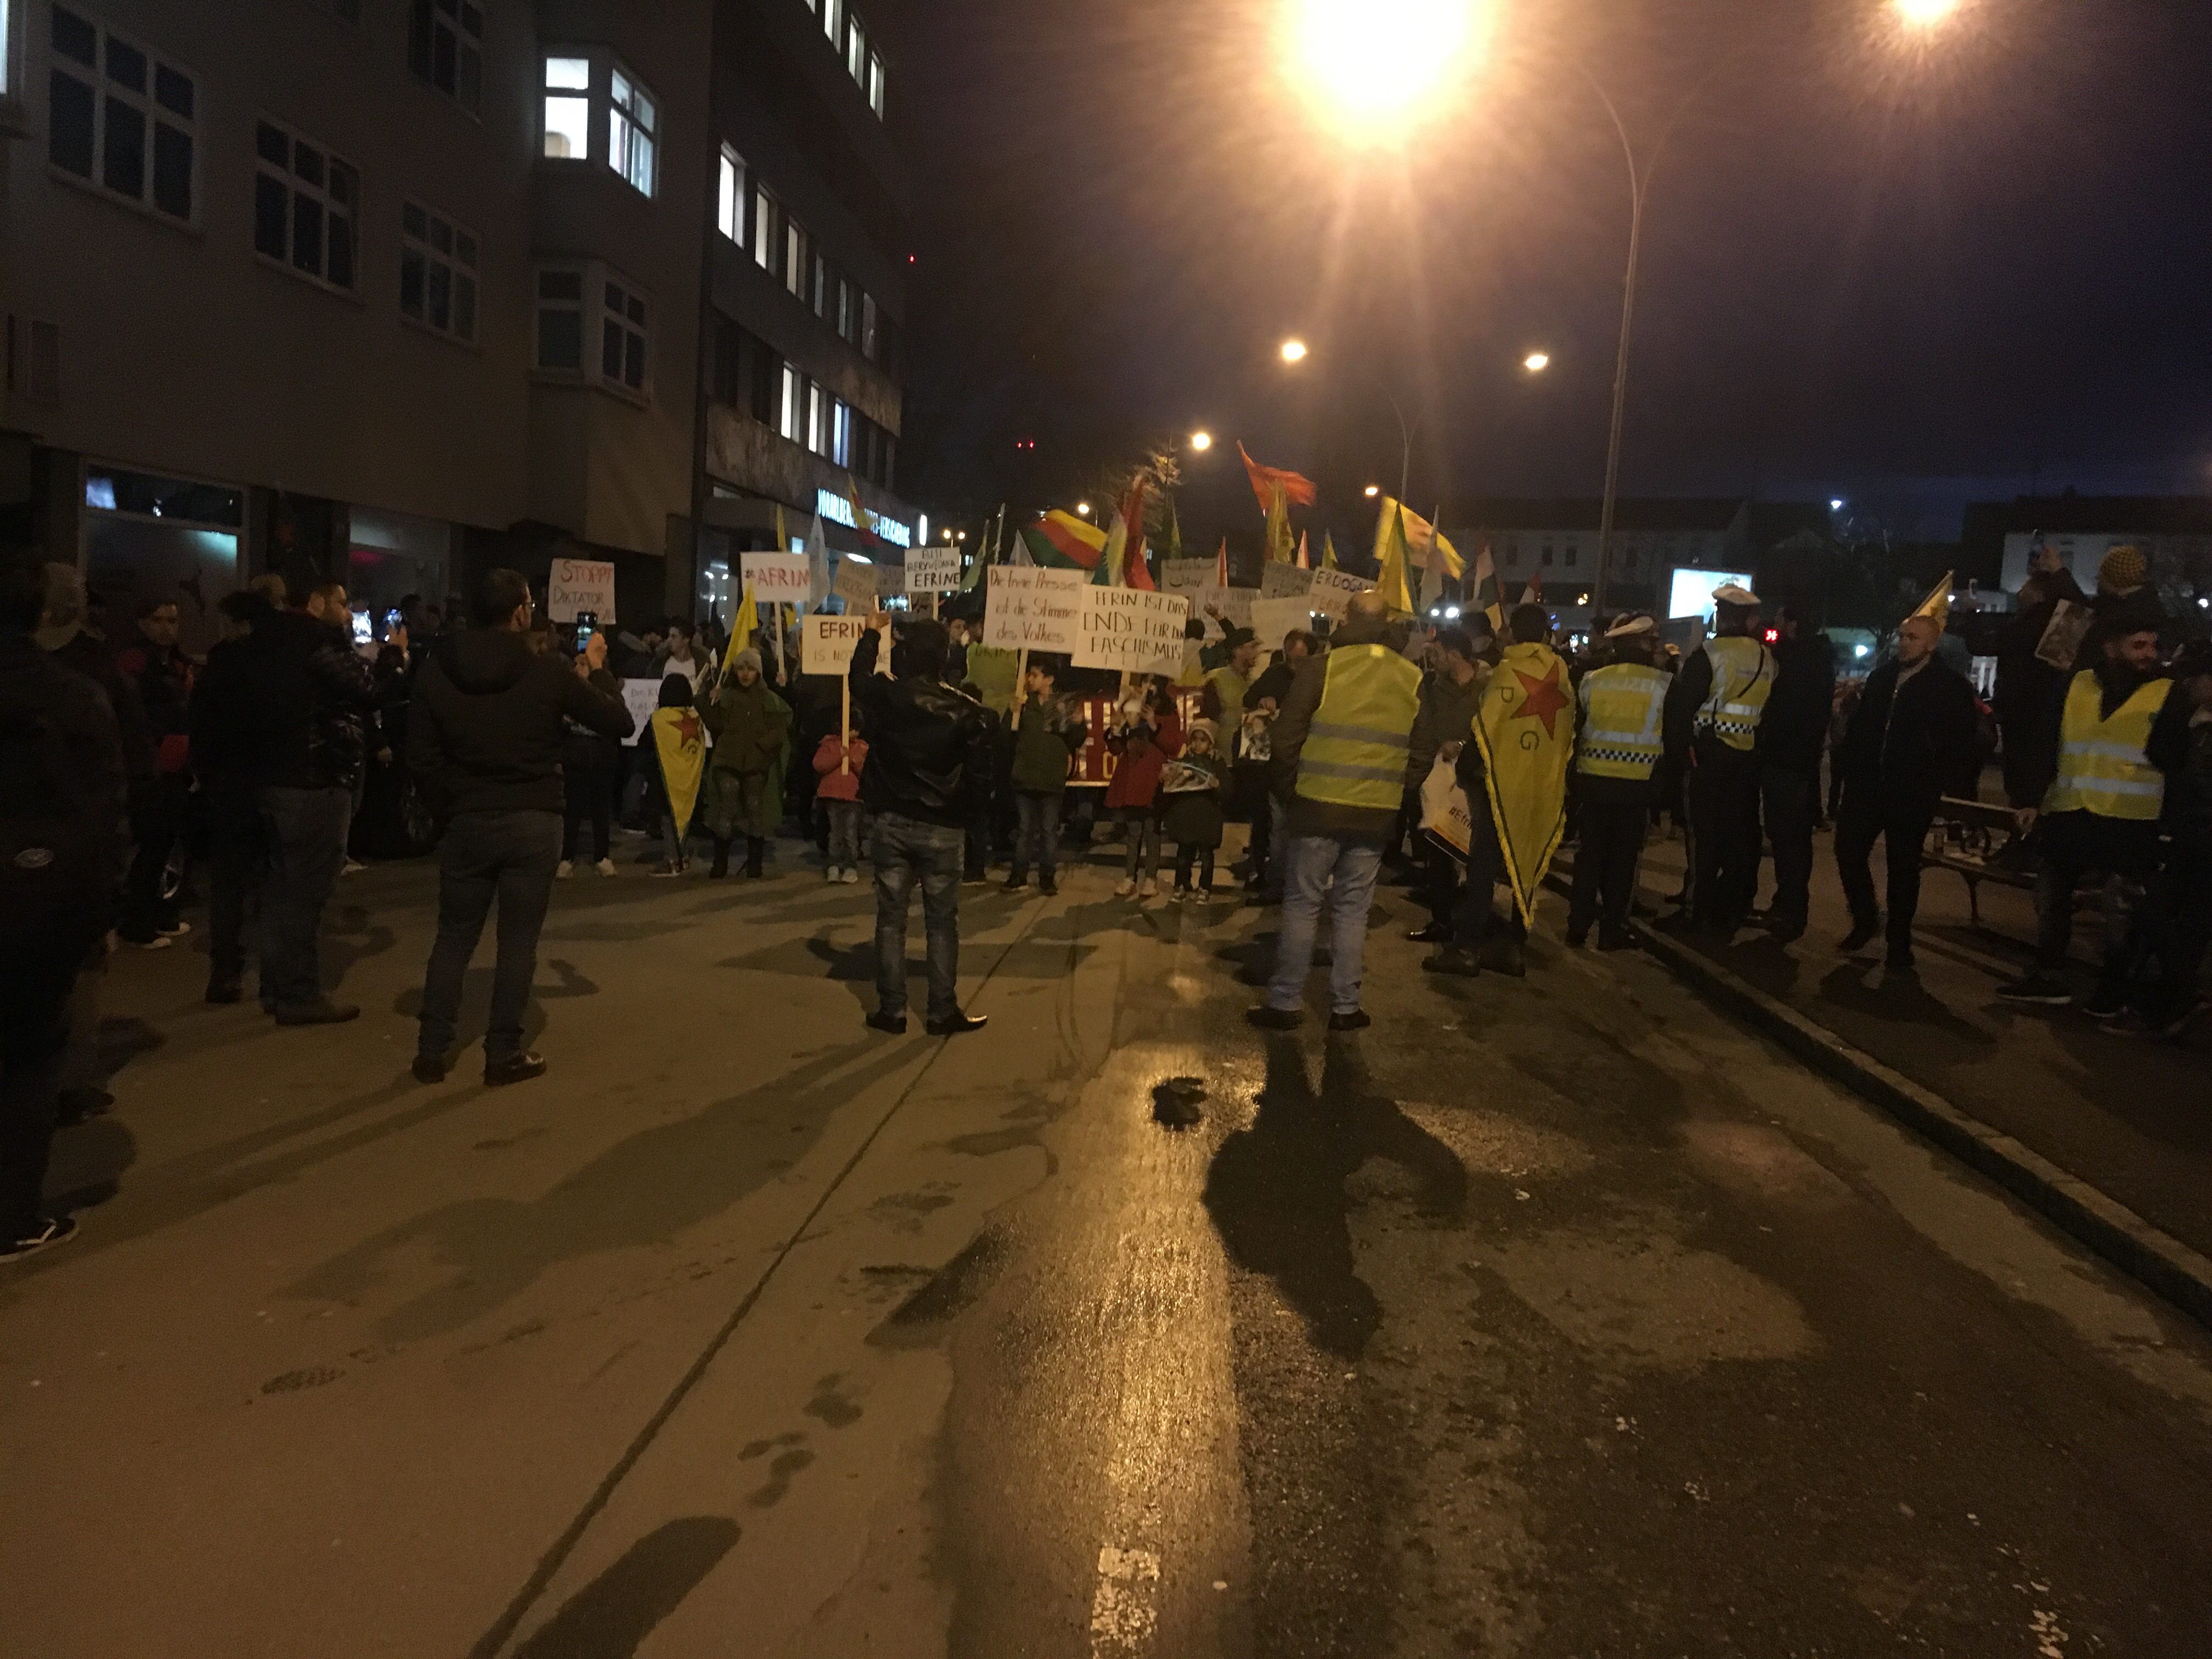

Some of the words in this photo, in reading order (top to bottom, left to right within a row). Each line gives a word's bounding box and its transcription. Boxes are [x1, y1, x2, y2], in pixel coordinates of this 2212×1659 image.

[915, 572, 960, 588] EFRINE
[1035, 571, 1077, 592] Presse
[1032, 597, 1078, 619] Stimme
[996, 621, 1017, 641] des
[1022, 622, 1065, 644] Volkes
[1091, 636, 1182, 660] FASCHISMUS
